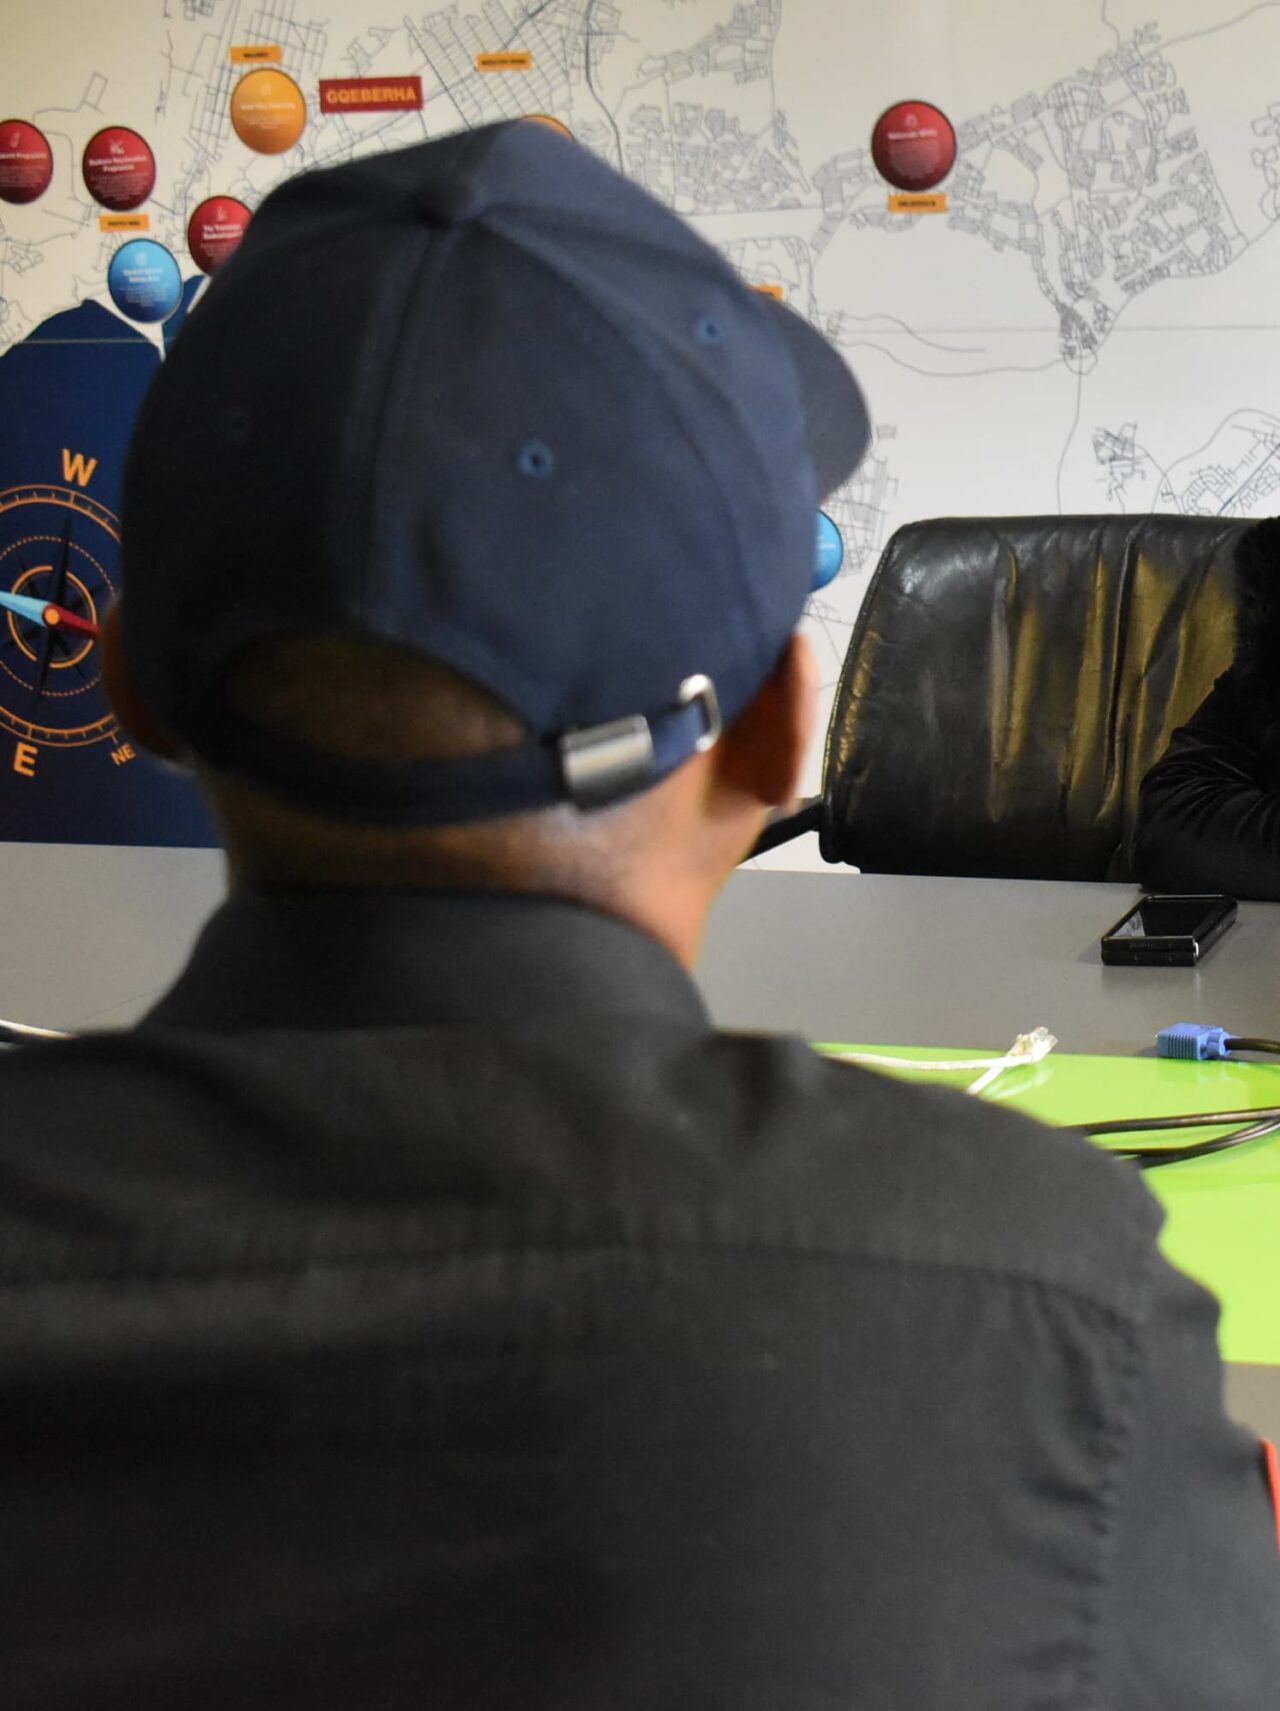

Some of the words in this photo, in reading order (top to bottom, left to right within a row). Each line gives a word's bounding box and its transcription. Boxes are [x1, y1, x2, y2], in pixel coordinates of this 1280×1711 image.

[61, 448, 97, 487] W
[13, 741, 38, 777] E
[110, 742, 136, 767] NE
